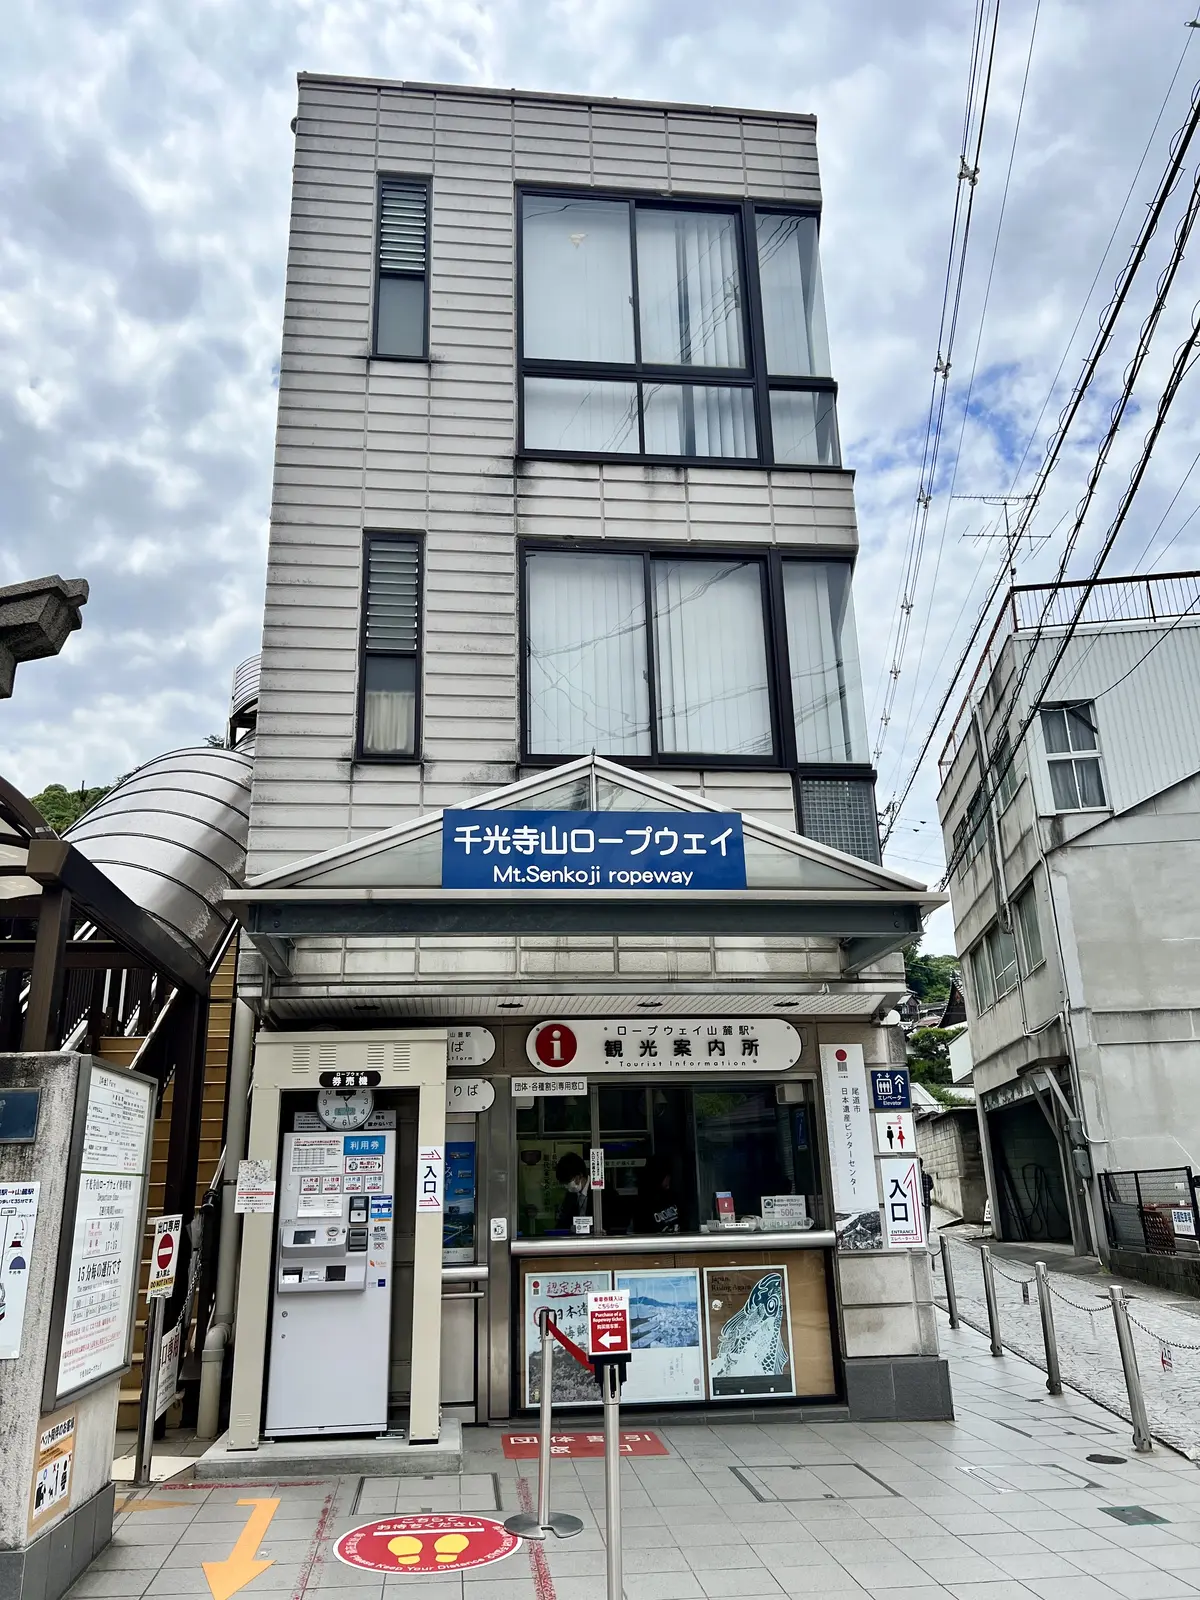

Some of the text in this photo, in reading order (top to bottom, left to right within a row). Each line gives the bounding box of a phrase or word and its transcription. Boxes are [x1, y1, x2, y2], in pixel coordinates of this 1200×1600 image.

[453, 825, 733, 856] 千光寺山ロープウェイ
[493, 865, 694, 886] Mt.Senkoji ropeway
[617, 1025, 750, 1036] ロープウェイ山麓駅
[604, 1039, 759, 1057] 観光案内所
[332, 1076, 368, 1086] 券売機
[851, 1087, 861, 1114] 尾道市
[350, 1140, 379, 1150] 利用券
[841, 1087, 856, 1195] 日本遺産ビジターセンター
[424, 1165, 437, 1194] 入口
[889, 1179, 908, 1222] 入口
[157, 1220, 181, 1234] 出口専用
[377, 1521, 482, 1530] お待ちください
